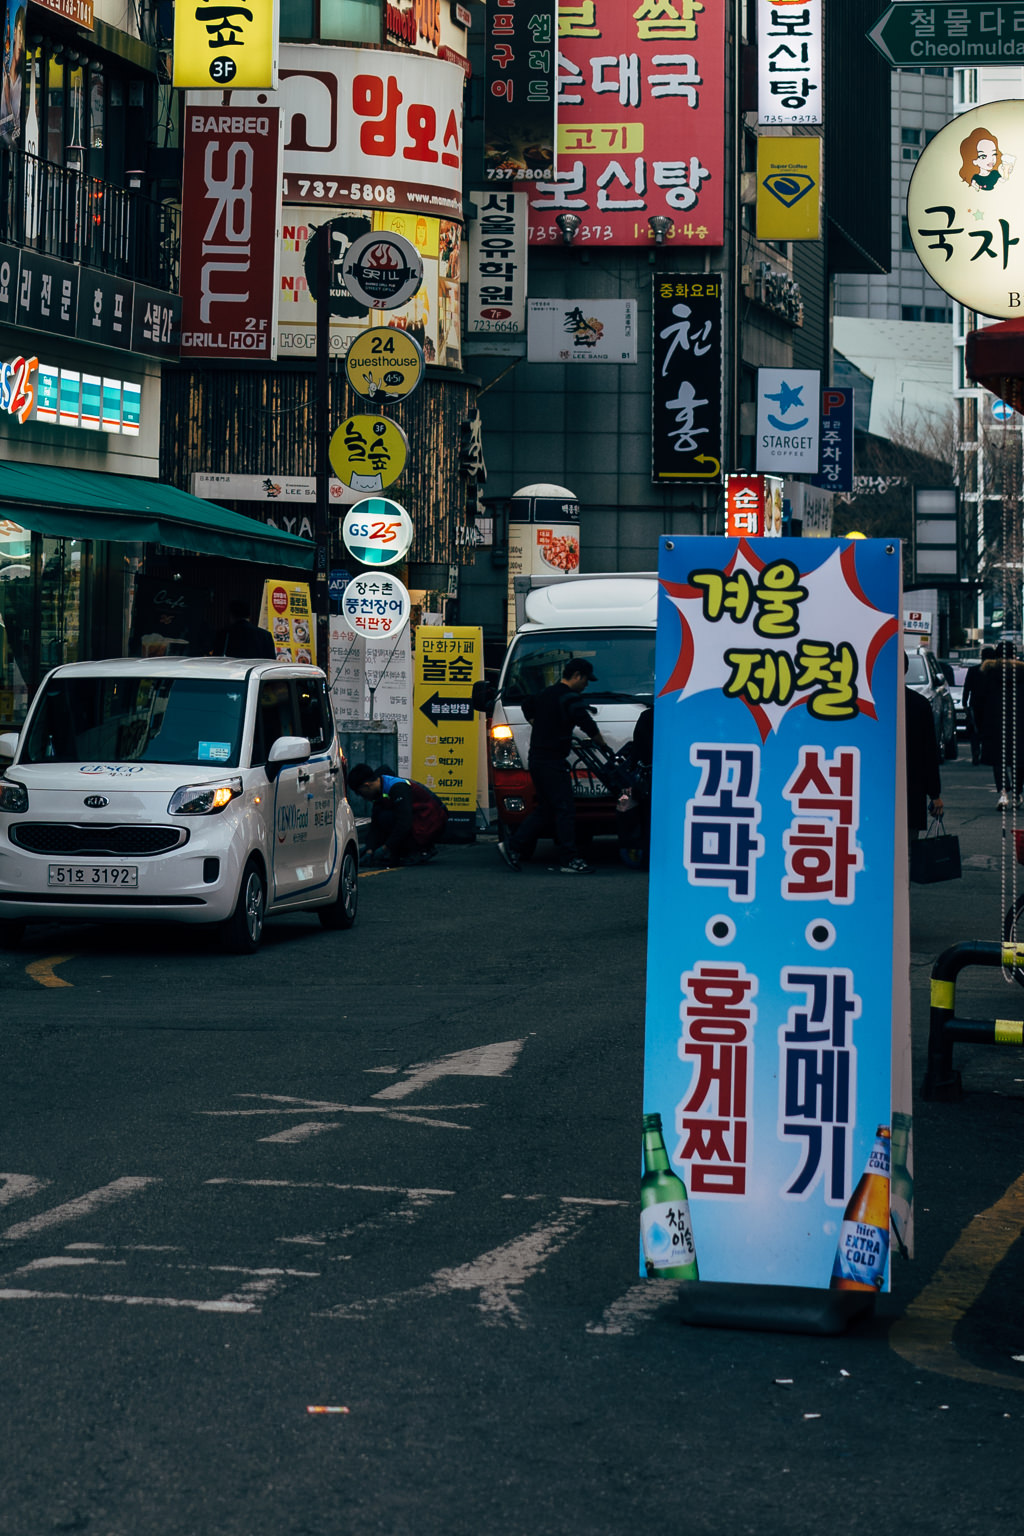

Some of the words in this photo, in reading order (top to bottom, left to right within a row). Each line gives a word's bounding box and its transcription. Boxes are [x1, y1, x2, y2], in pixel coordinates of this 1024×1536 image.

[527, 13, 551, 102] 샐러드
[767, 8, 818, 109] 보신탕
[212, 60, 234, 78] 3F
[191, 116, 270, 136] BARBEQ
[764, 114, 818, 124] 735-0373
[487, 167, 515, 180] 737
[517, 167, 551, 180] 5808
[297, 179, 396, 203] 737-5808
[530, 157, 710, 212] 보신탕
[917, 205, 1020, 270] 국자
[479, 194, 517, 306] 서울유학원
[659, 283, 719, 299] 중화요리
[91, 287, 124, 331] 호프
[372, 299, 387, 307] 2F
[490, 309, 502, 318] 7F
[144, 306, 173, 343] 스릴2F
[245, 317, 268, 330] 2F
[474, 320, 519, 333] 723-6646
[182, 332, 228, 347] GRILL
[230, 333, 267, 350] HOF
[280, 333, 316, 348] HOF
[371, 337, 395, 353] 24
[350, 356, 418, 369] guesthouse
[823, 391, 846, 416] P
[762, 435, 813, 449] STARGET
[822, 431, 842, 481] 주차장
[733, 487, 759, 535] 순대
[349, 521, 402, 543] GS25
[329, 578, 350, 590] ADT
[355, 582, 393, 596] 장수촌
[345, 598, 403, 615] 풍천장어
[688, 559, 808, 638] 겨울
[355, 616, 393, 631] 직판장
[422, 640, 475, 654] 만화카페
[422, 654, 473, 682] 놀숲
[722, 639, 859, 720] 제철
[431, 702, 470, 714] 놀숲방향
[439, 736, 464, 744] 보다가!
[79, 765, 144, 774] CESCO
[87, 797, 106, 806] KIA
[690, 749, 759, 896] 꼬막
[787, 751, 858, 899] 석화
[56, 867, 84, 883] 51호
[91, 867, 130, 884] 3192
[679, 967, 753, 1197] 홍게찜
[784, 973, 855, 1200] 과메기
[856, 1223, 876, 1237] hite
[845, 1235, 880, 1254] EXTRA
[846, 1250, 876, 1266] COLD
